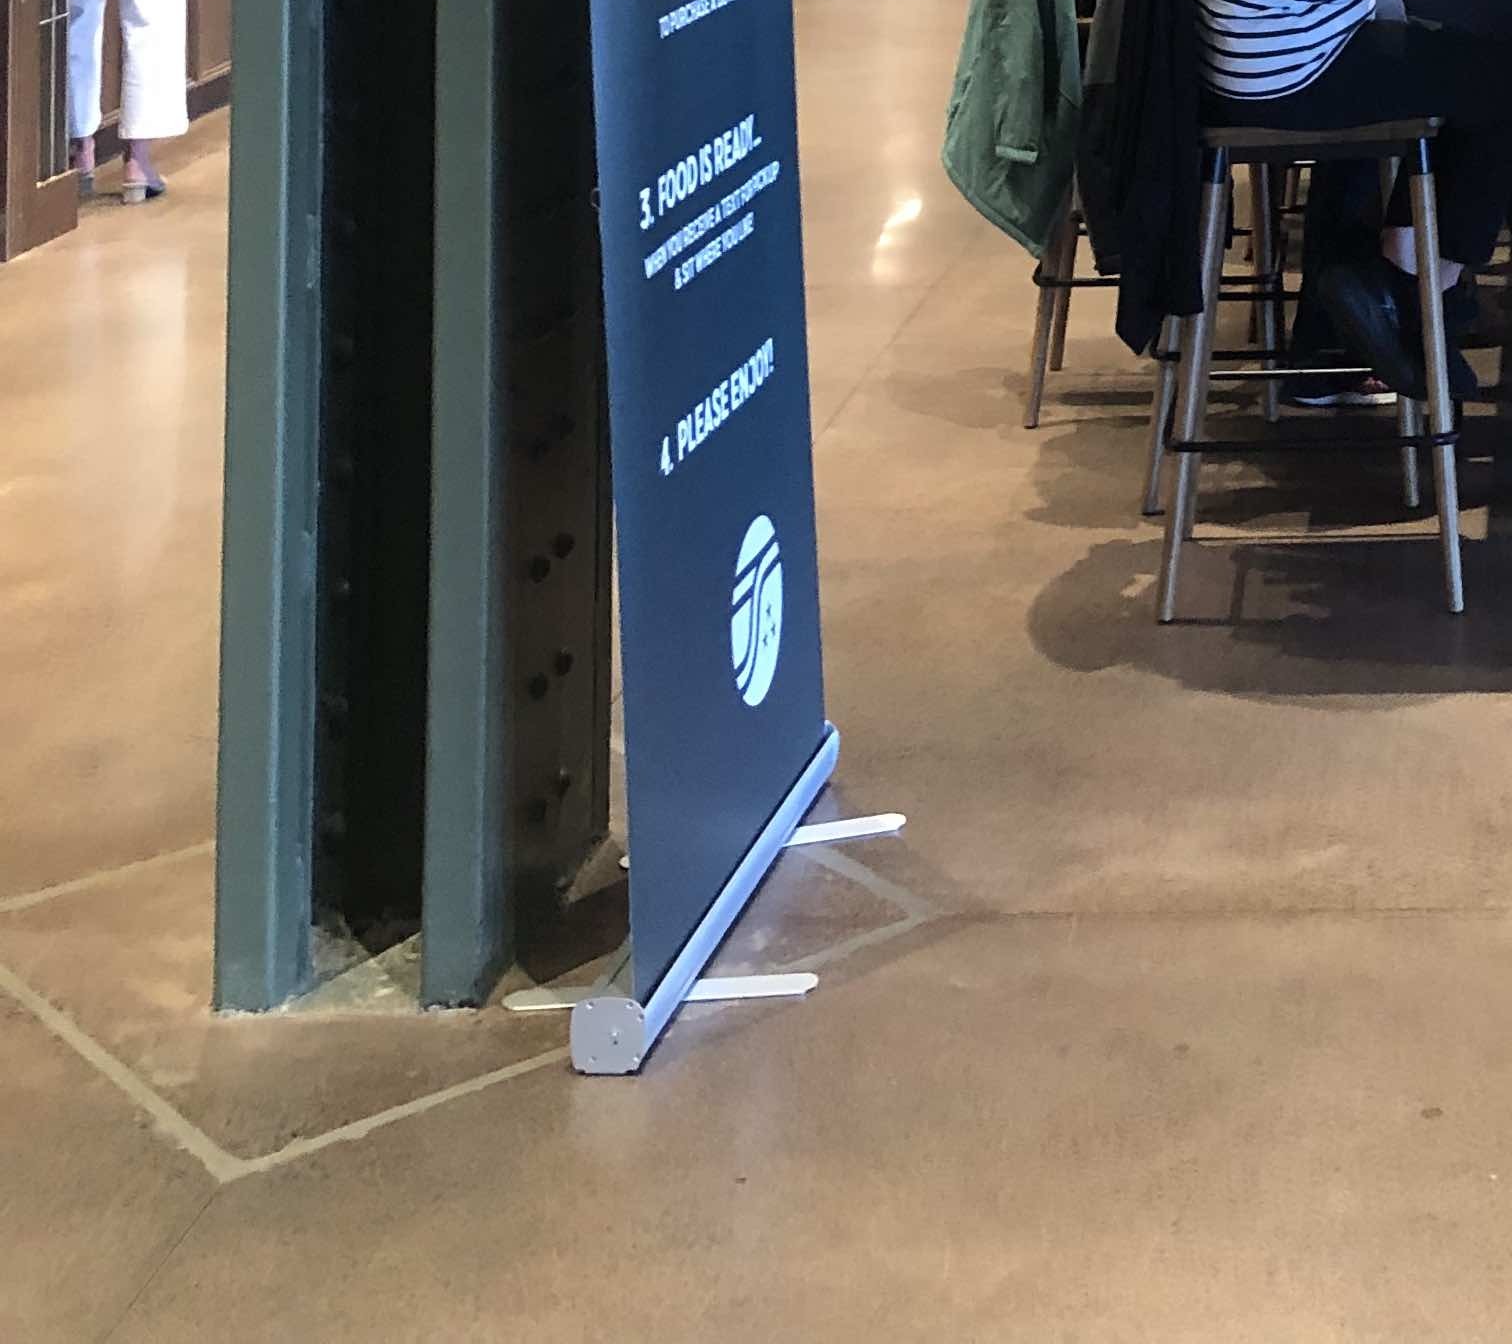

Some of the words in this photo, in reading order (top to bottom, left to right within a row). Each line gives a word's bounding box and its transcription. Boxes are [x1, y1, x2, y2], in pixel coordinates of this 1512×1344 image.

[640, 187, 654, 230] 3.
[658, 155, 697, 216] FOOD
[699, 144, 712, 185] IS
[661, 436, 674, 476] 4.
[677, 380, 729, 461] PLEASE
[731, 337, 774, 411] ENJOY!
